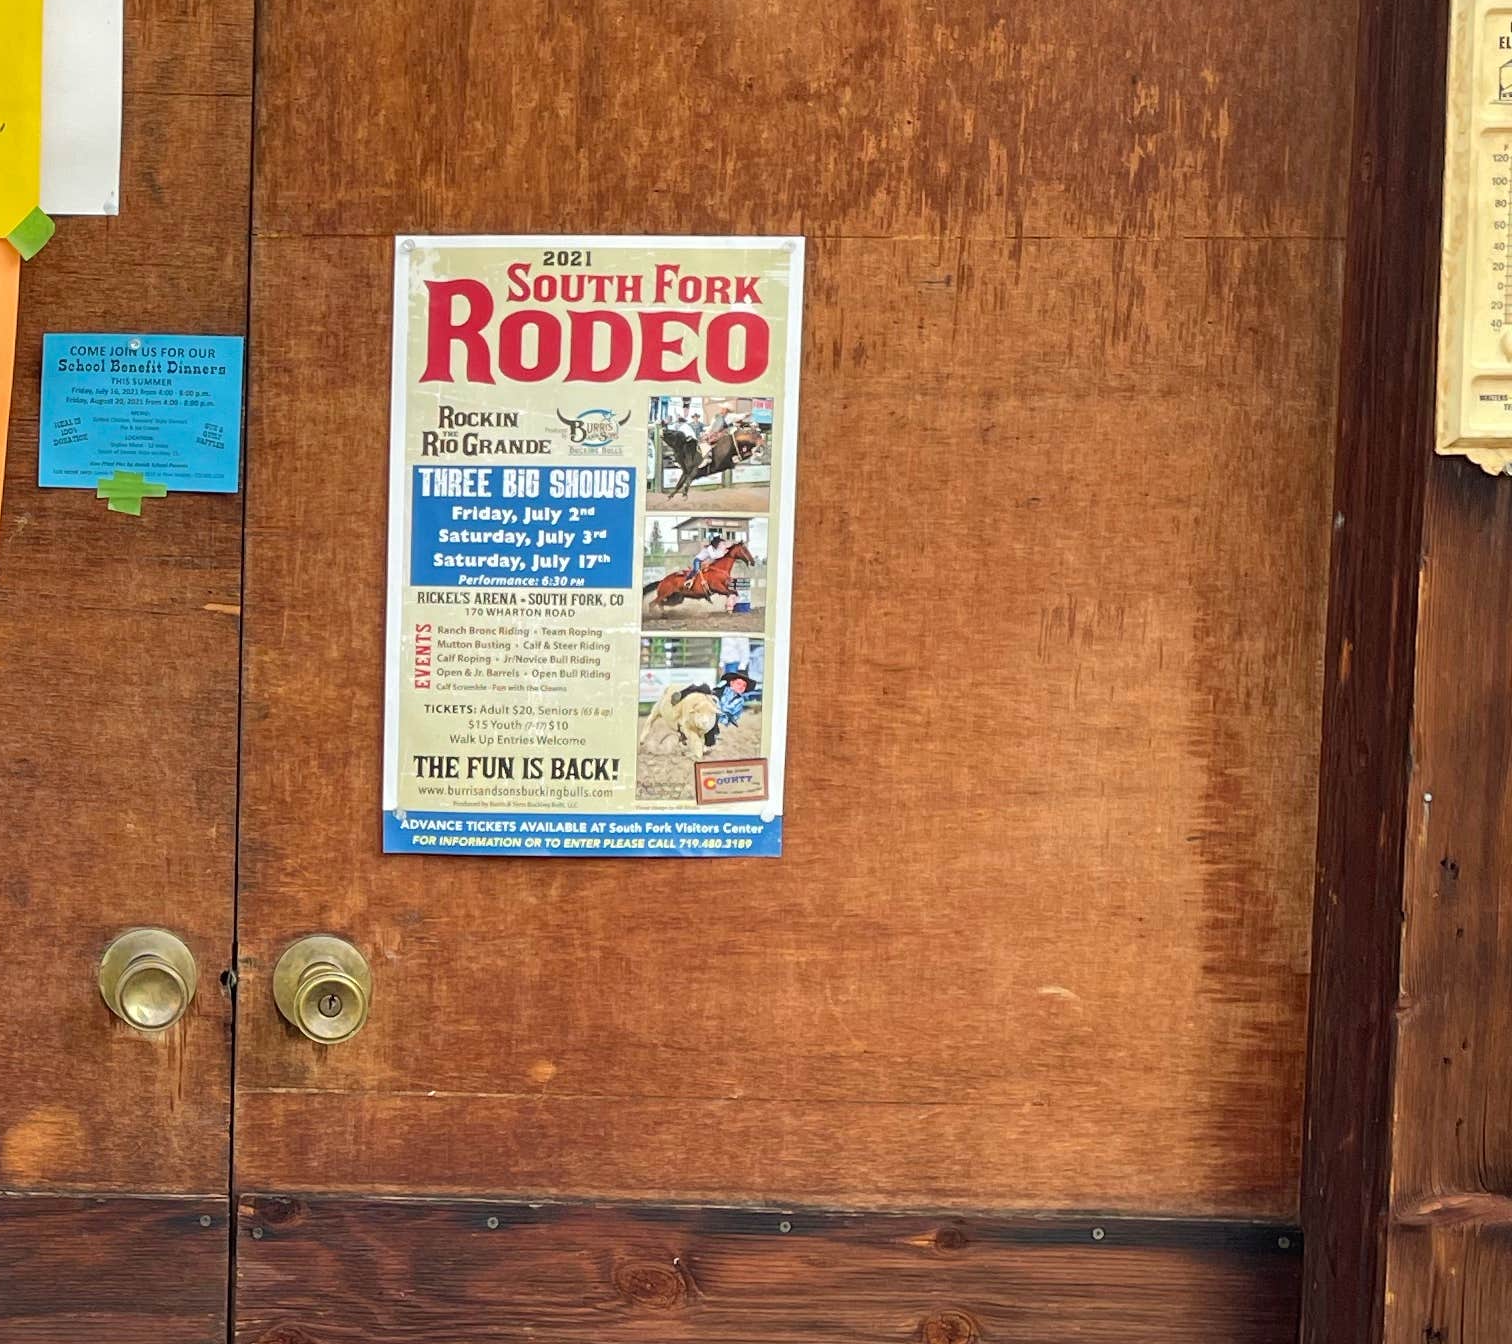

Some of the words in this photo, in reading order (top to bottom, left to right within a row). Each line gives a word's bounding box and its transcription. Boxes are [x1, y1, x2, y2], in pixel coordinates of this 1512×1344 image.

[543, 251, 592, 267] 2021
[507, 263, 643, 304] SOUTH
[652, 264, 763, 305] FORK
[419, 278, 770, 386] RODEO
[70, 346, 106, 356] COME
[110, 347, 137, 357] JOIN
[142, 347, 157, 357] US
[161, 348, 184, 357] FOR
[189, 348, 216, 358] OUR
[58, 359, 105, 373] School
[110, 361, 162, 373] Benefit
[167, 361, 226, 375] Dinners
[132, 378, 172, 386] SUMMER
[438, 405, 519, 429] ROCKIN
[422, 431, 458, 457] RIO
[463, 432, 552, 456] GRANDE
[418, 468, 492, 497] THREE
[549, 470, 630, 499] SHOWS
[451, 506, 518, 523] Friday,
[522, 507, 562, 525] July
[438, 529, 531, 548] Saturday,
[536, 530, 575, 548] July
[433, 553, 526, 572] Saturday,
[531, 554, 570, 572] July
[458, 575, 539, 586] Performance:
[542, 576, 567, 586] 6:30
[570, 578, 584, 586] PM
[417, 592, 470, 604] RICKEL'S
[474, 593, 517, 605] ARENA
[528, 593, 567, 606] SOUTH
[571, 593, 607, 607] FORK,
[609, 594, 624, 606] CO
[465, 608, 483, 616] 170
[487, 608, 542, 617] WHARTON
[545, 609, 576, 618] ROAD
[414, 623, 432, 690] EVENTS
[413, 756, 459, 778] THE
[466, 756, 514, 779] FUN
[522, 757, 543, 779] IS
[550, 758, 620, 780] BACK!
[400, 820, 464, 831] ADVANCE
[466, 821, 516, 832] TICKETS
[520, 822, 587, 832] AVAILABLE
[590, 822, 606, 833] AT
[609, 823, 642, 834] South
[646, 823, 672, 834] Fork
[675, 823, 719, 834] Visitors
[723, 824, 764, 834] Center
